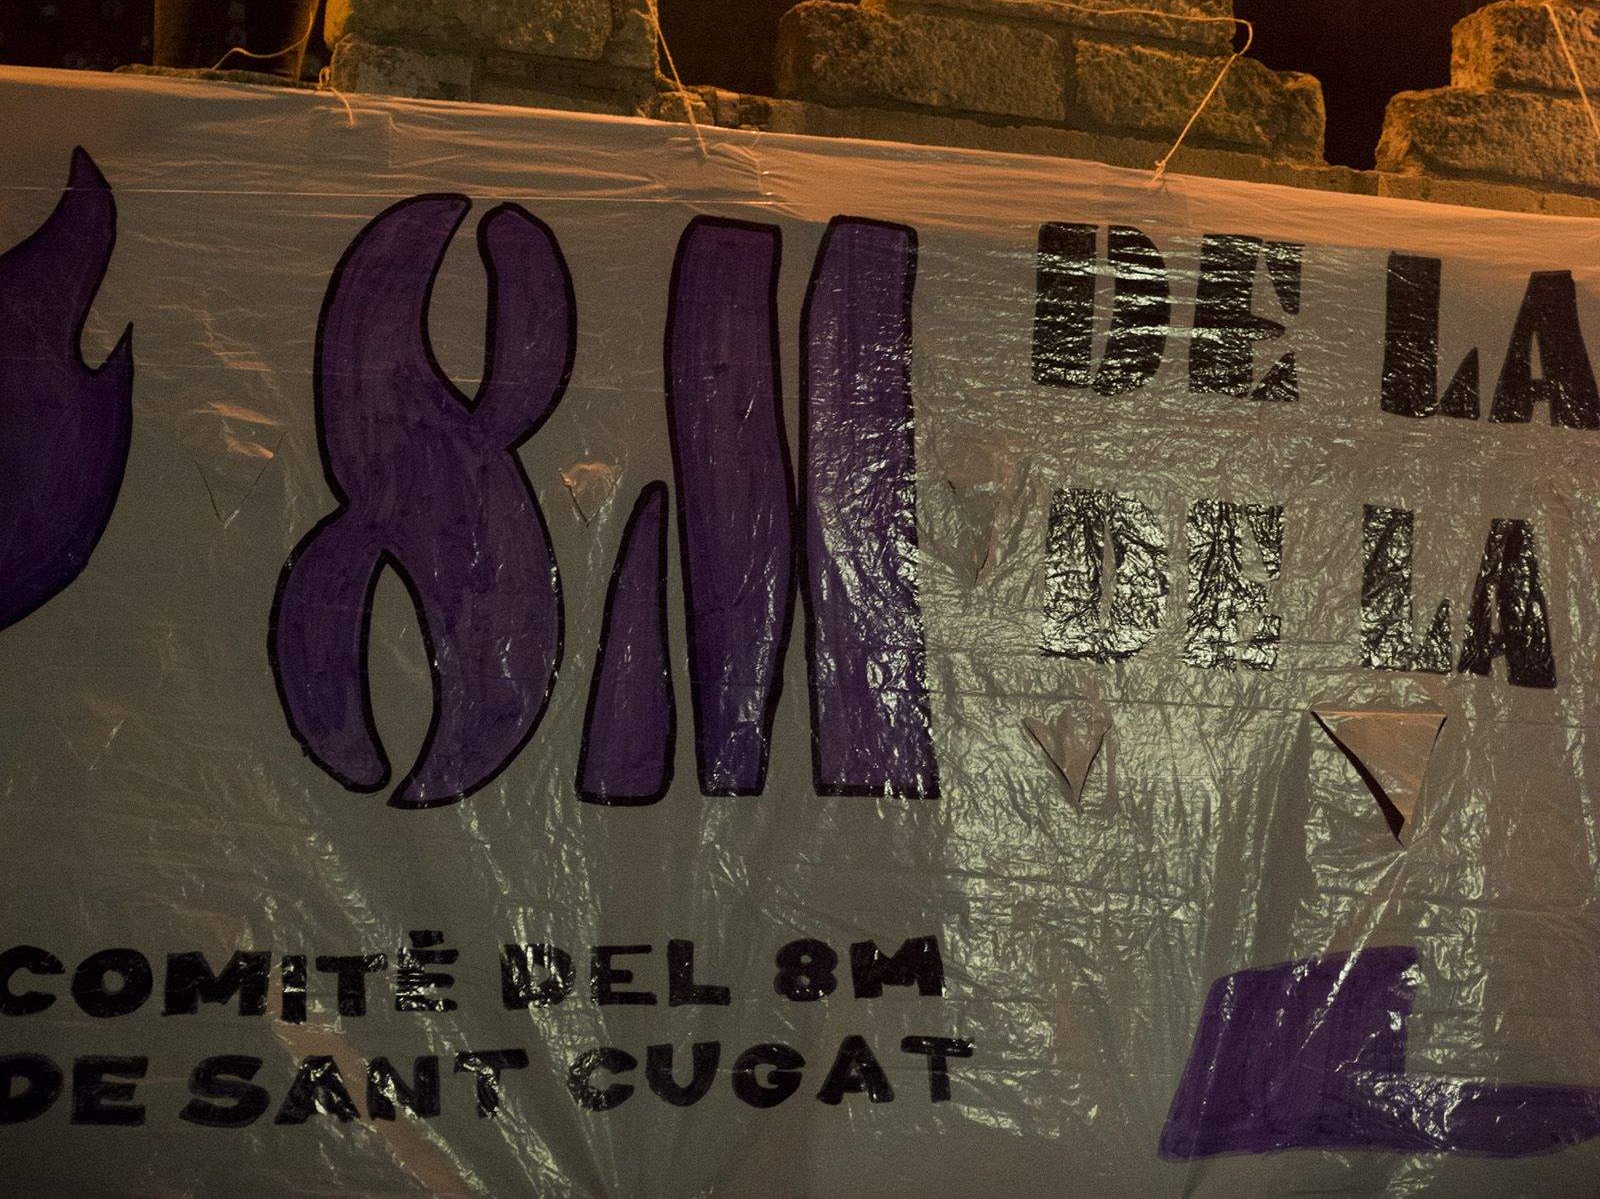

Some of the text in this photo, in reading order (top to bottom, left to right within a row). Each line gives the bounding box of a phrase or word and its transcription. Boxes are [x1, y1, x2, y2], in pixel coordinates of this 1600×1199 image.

[1031, 220, 1600, 430] DE LA
[1037, 486, 1557, 690] DE LA
[0, 929, 945, 1024] COMITÉ DEL 8M
[0, 1034, 975, 1129] DE SANT CUGAT
